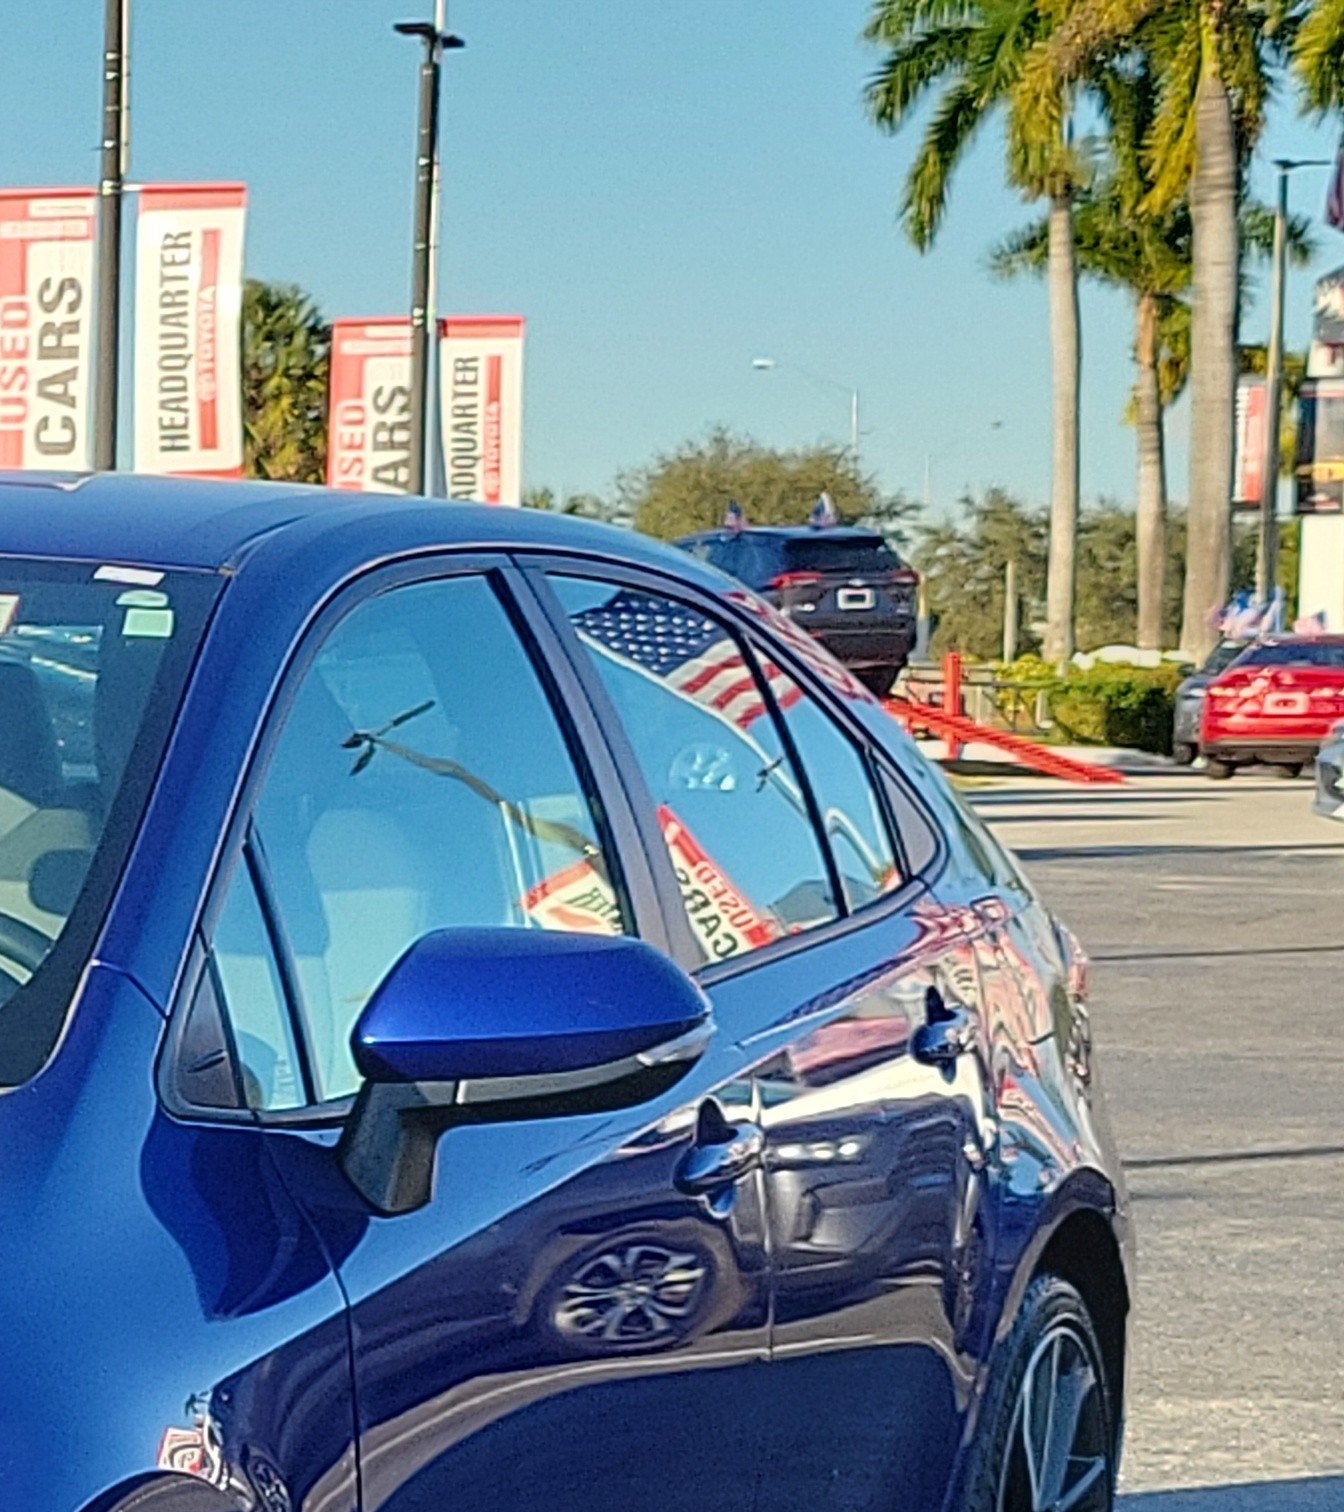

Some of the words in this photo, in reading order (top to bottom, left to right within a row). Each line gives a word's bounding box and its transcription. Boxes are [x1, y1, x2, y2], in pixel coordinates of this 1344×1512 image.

[33, 276, 83, 456] CARS
[157, 230, 193, 452] HEADQUARTER
[371, 385, 413, 495] ARS
